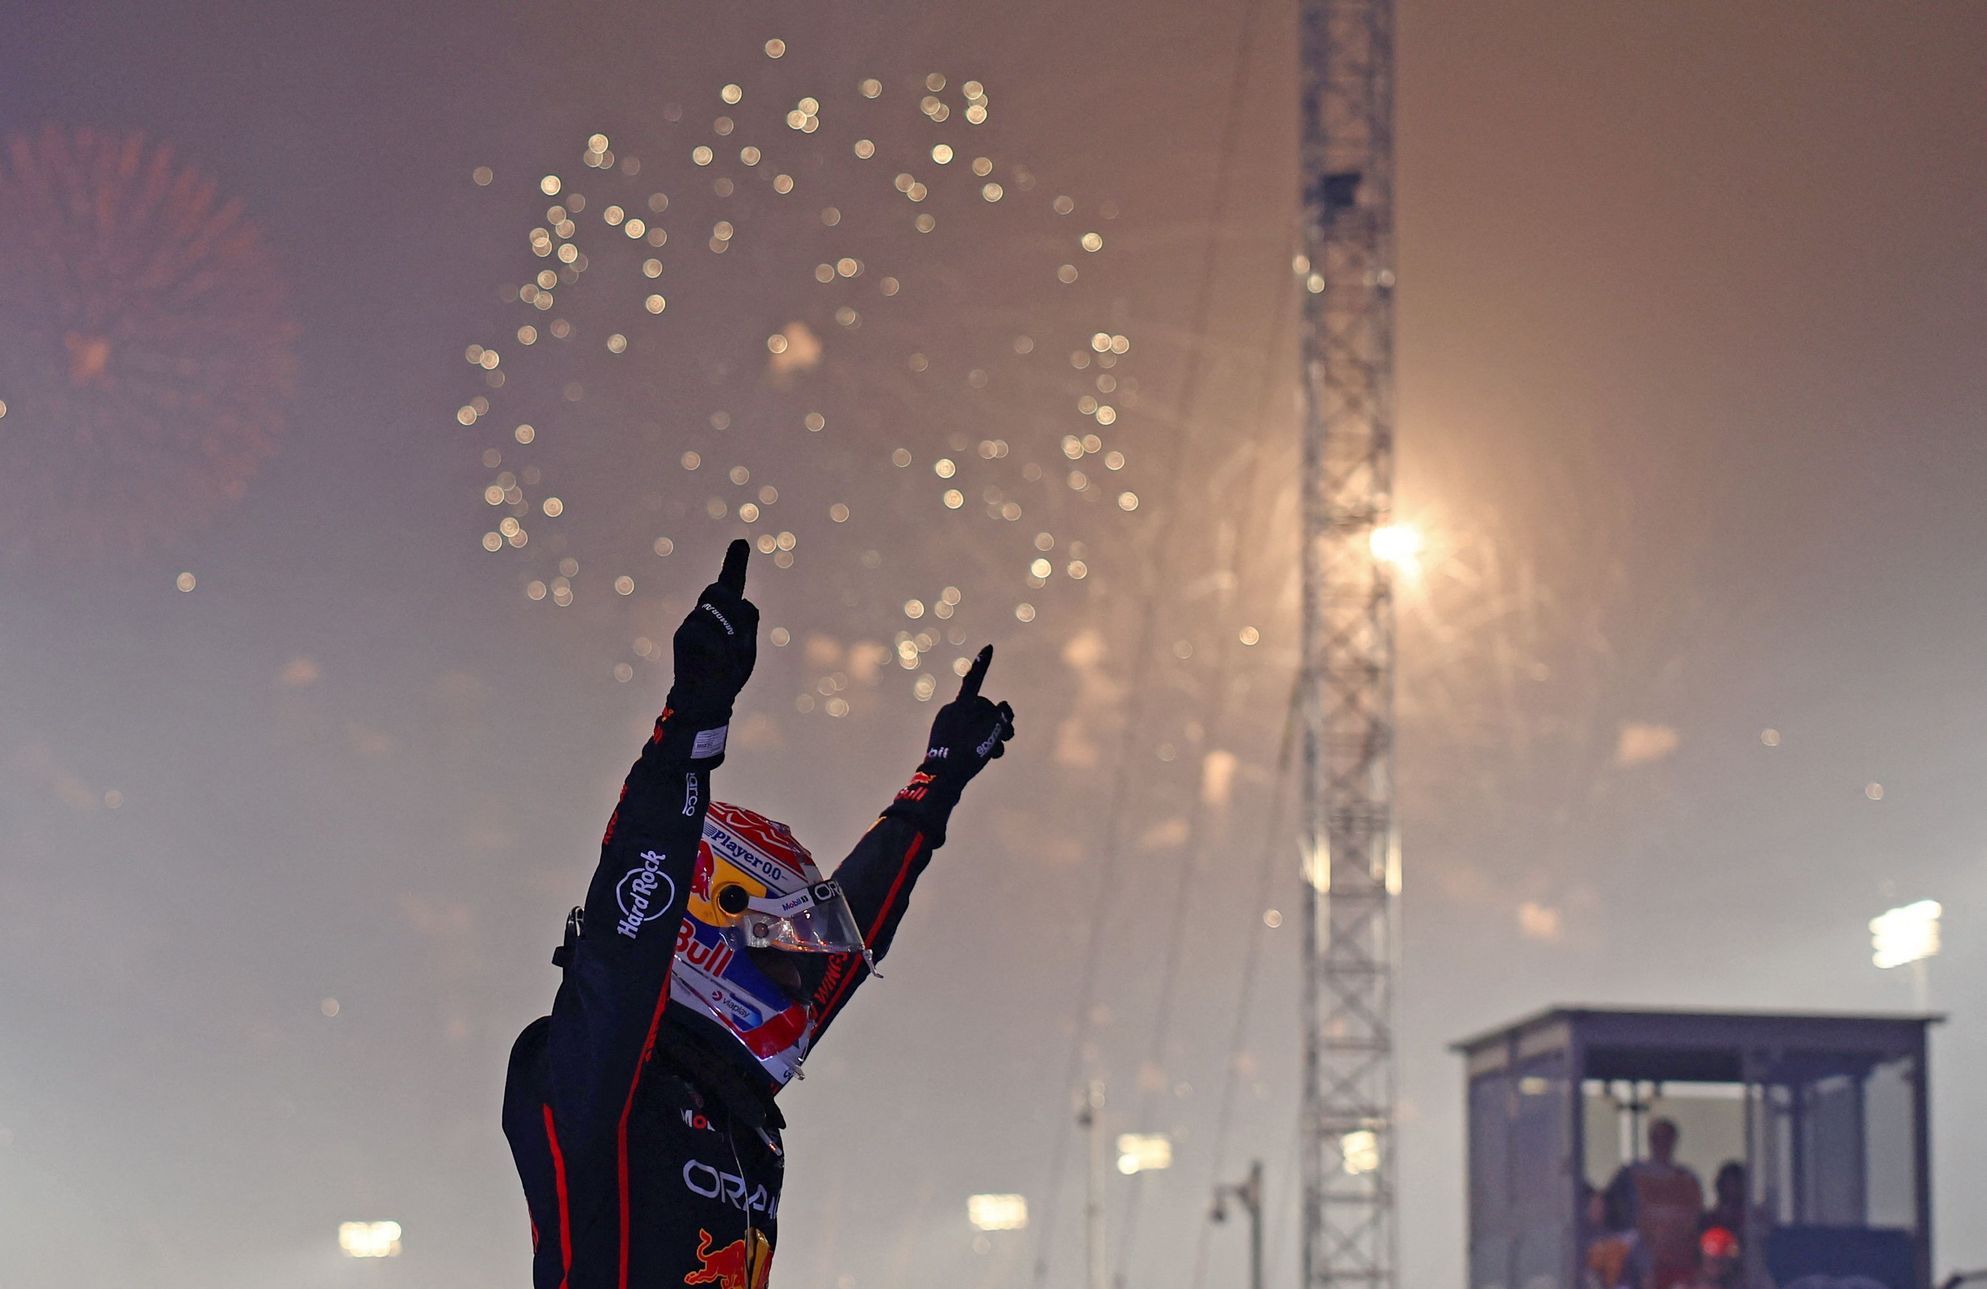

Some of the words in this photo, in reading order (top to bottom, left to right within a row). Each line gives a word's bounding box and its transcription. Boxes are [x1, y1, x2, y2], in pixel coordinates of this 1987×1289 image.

[632, 850, 666, 896] Rock
[616, 891, 649, 939] Hard
[722, 997, 750, 1018] viaplay
